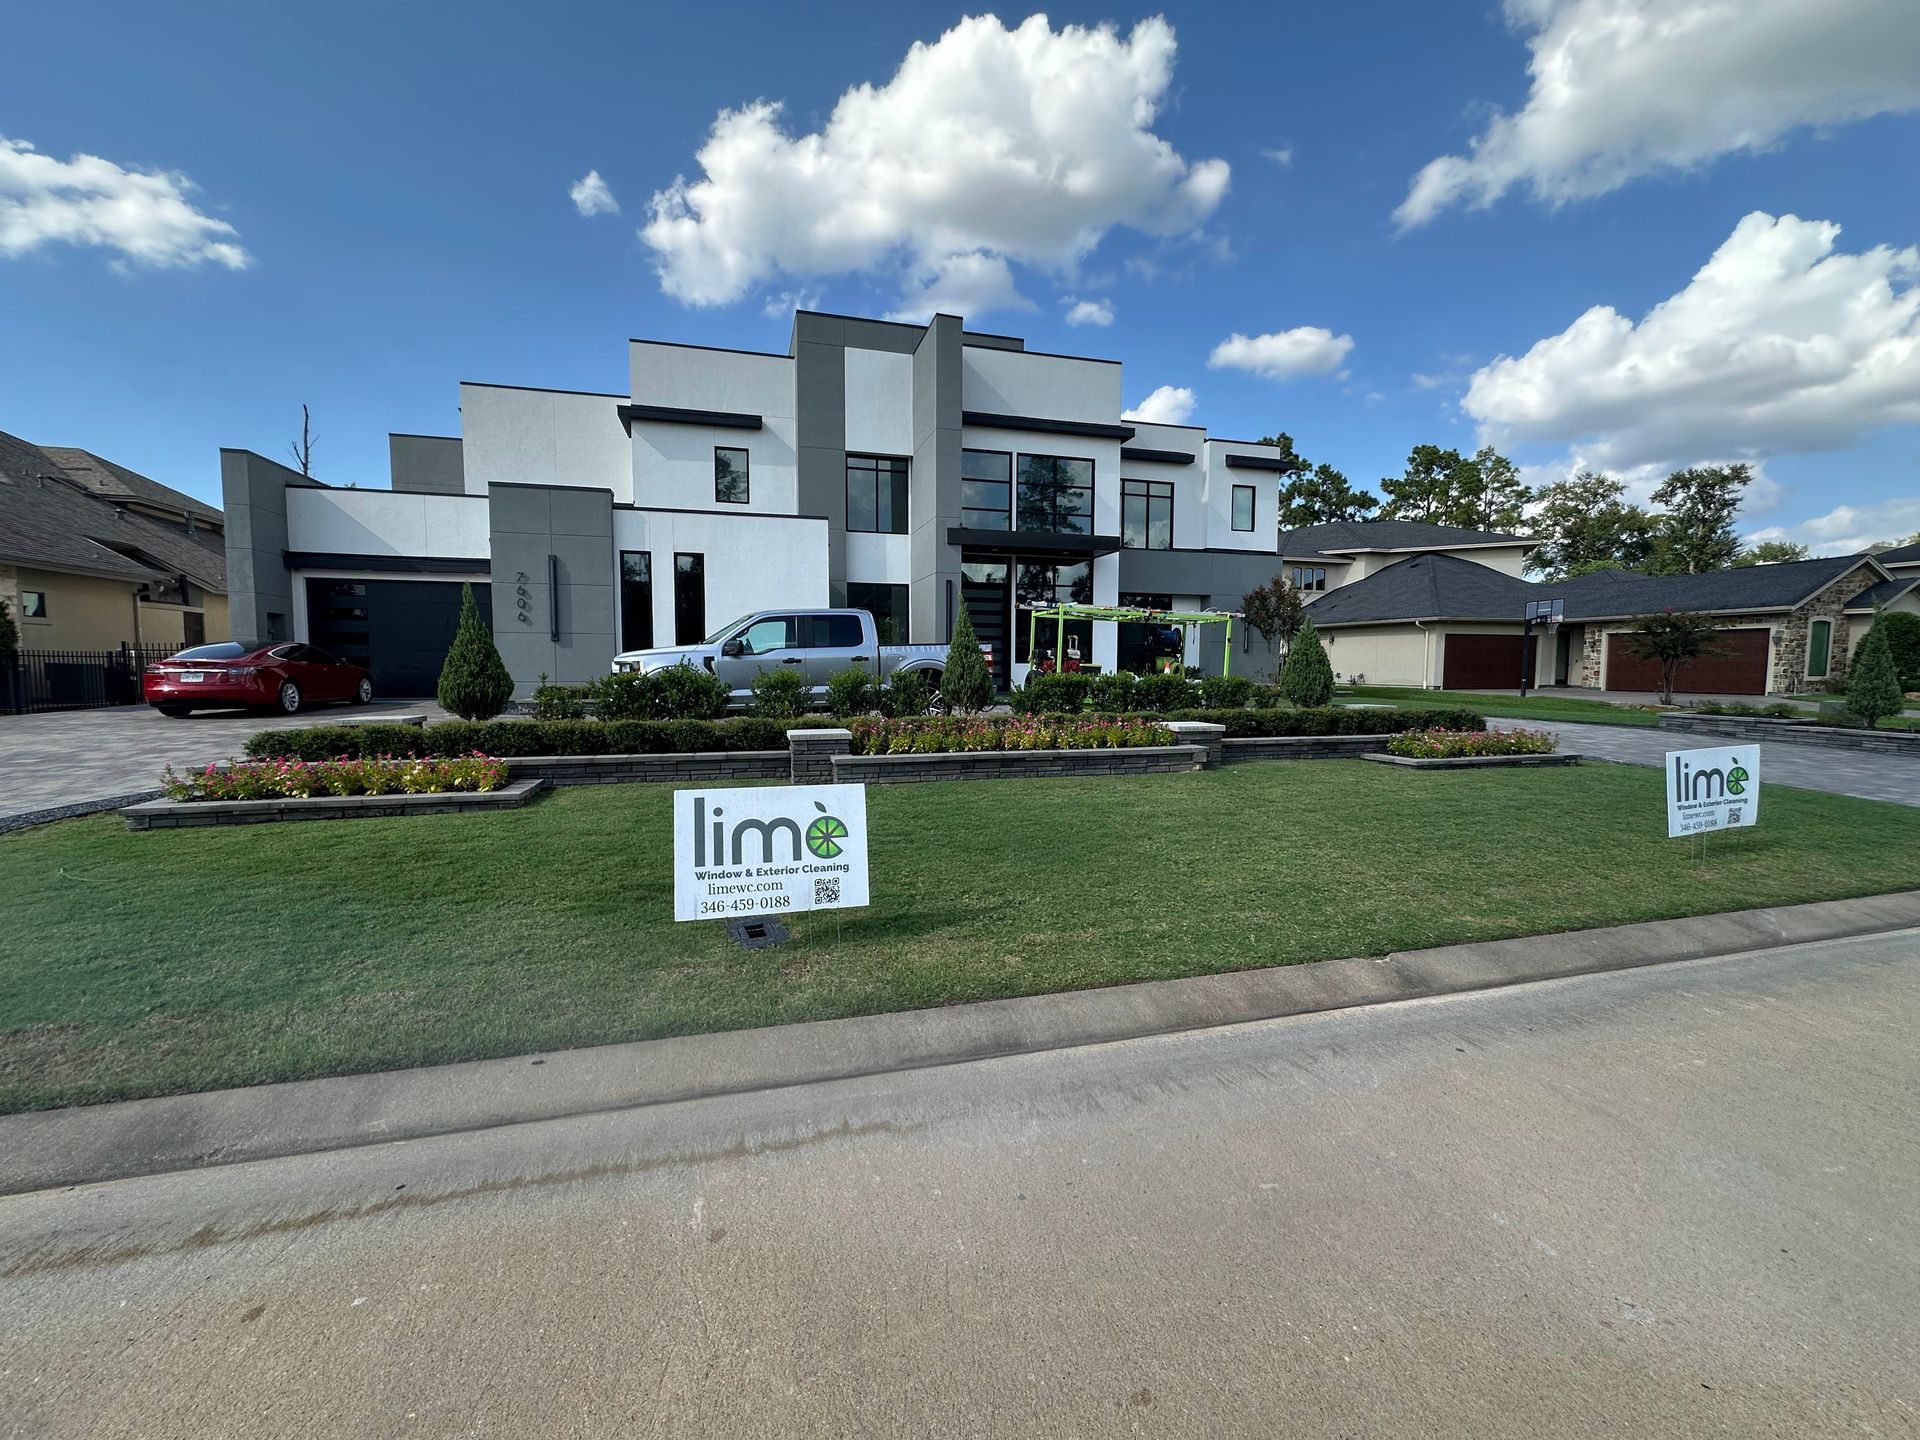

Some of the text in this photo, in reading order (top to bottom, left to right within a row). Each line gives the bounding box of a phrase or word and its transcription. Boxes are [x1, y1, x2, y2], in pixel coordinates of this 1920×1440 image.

[1677, 803, 1698, 811] Window
[1723, 797, 1748, 805] Cleaning
[1682, 810, 1715, 820] limewc.com
[1680, 819, 1718, 832] 346-459-0188
[695, 862, 850, 881] Window & Exterior Cleaning
[707, 880, 783, 895] limewc.com
[701, 896, 790, 914] 346-459-0188
